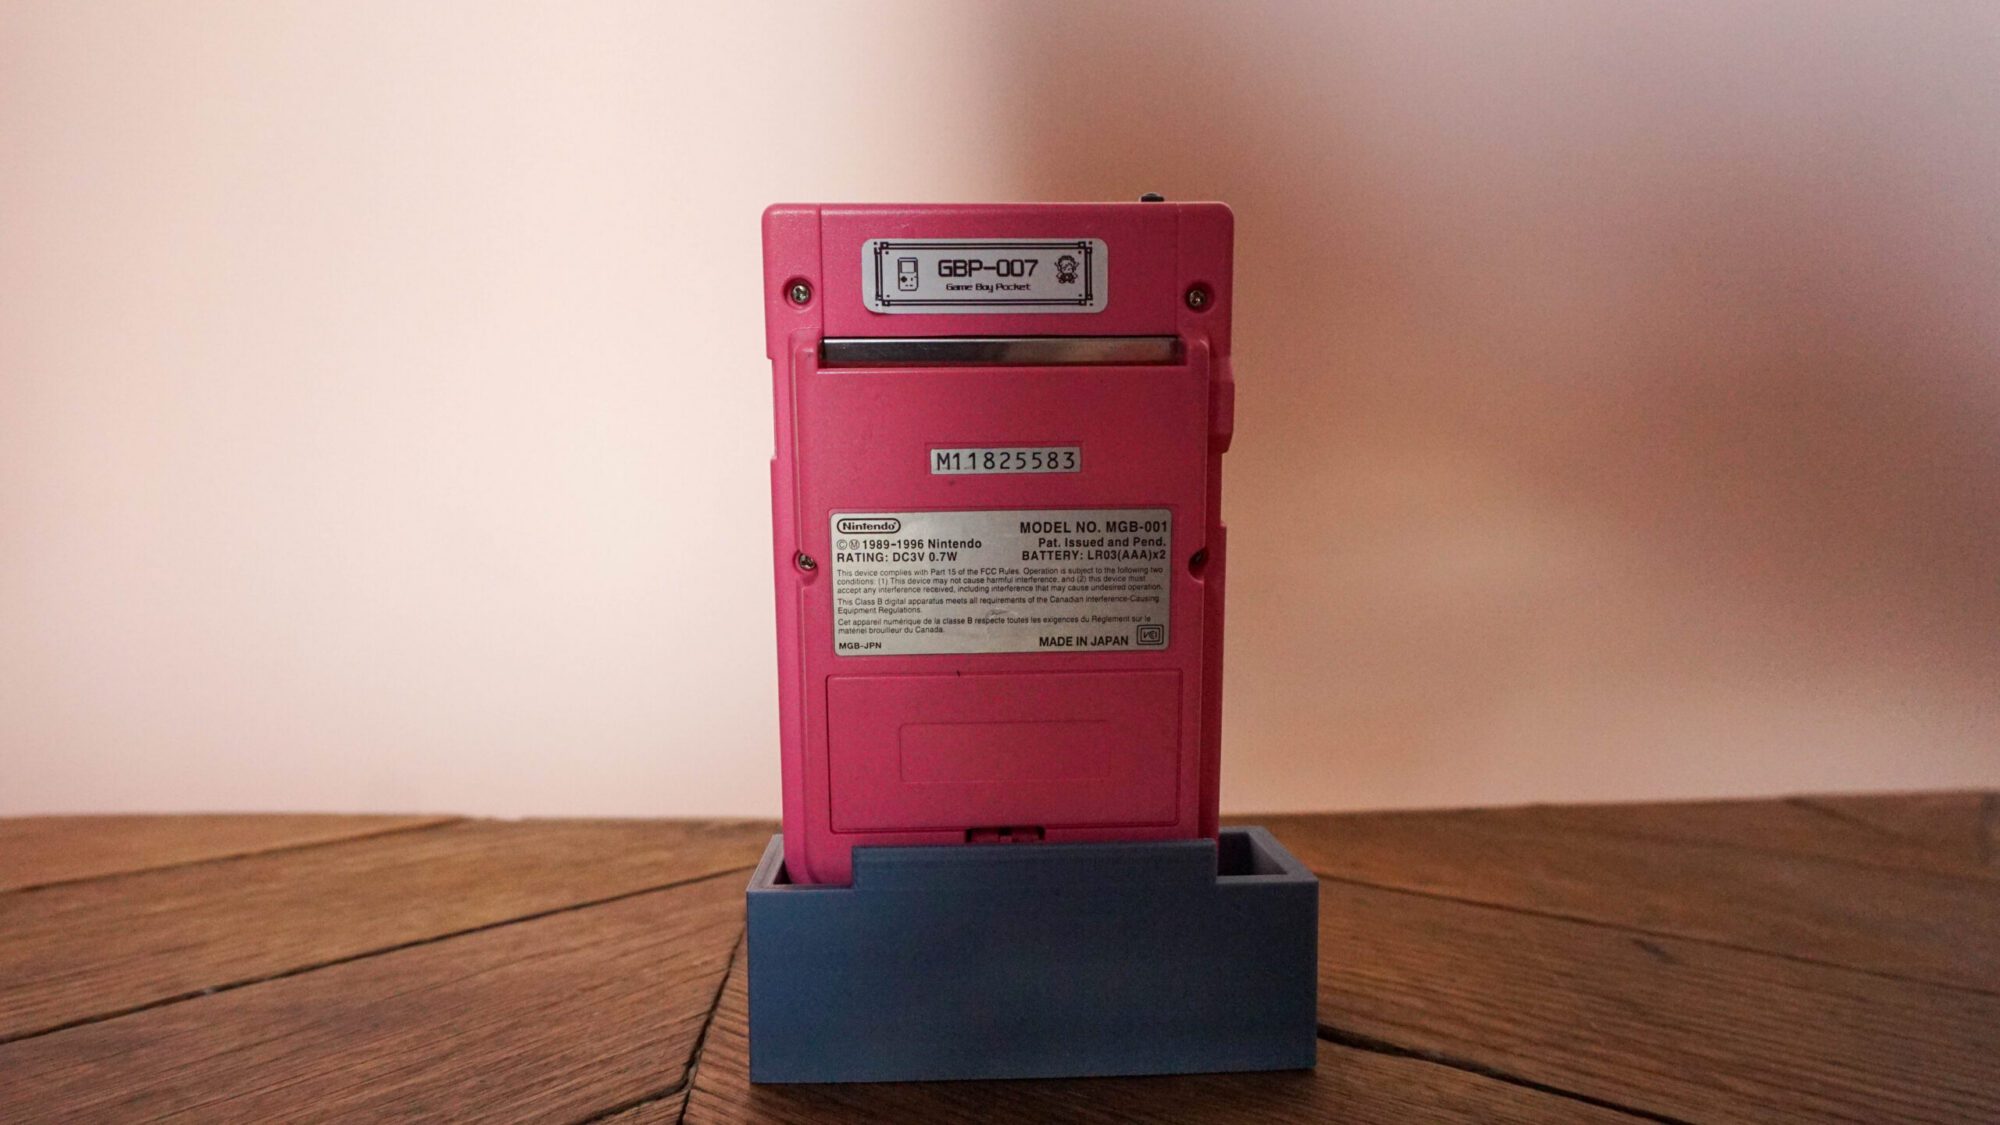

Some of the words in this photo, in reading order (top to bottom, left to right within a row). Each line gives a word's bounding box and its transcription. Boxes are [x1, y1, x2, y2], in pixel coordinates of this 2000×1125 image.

[938, 259, 1038, 277] GBP-007
[946, 283, 973, 291] Game
[976, 283, 994, 293] Boy
[996, 283, 1031, 291] Pocket
[937, 452, 1075, 471] M11825583
[1020, 521, 1071, 534] MODEL
[1076, 521, 1101, 533] NO.
[1106, 521, 1167, 532] MGB-001
[862, 539, 924, 550] 1989-1996
[928, 538, 982, 549] Nintendo
[1038, 538, 1061, 548] Pat.
[1064, 537, 1104, 547] Issued
[1107, 537, 1129, 547] and
[1133, 537, 1166, 547] Pend.
[837, 552, 888, 563] RATING:
[893, 552, 925, 562] DC3V
[929, 551, 958, 561] 0.7W
[1022, 550, 1084, 561] BATTERY:
[1087, 550, 1166, 561] LR03(AAA)x2
[837, 569, 852, 577] This
[880, 569, 912, 578] complies
[958, 568, 966, 576] of
[967, 568, 978, 576] the
[1023, 568, 1058, 576] Operation
[1068, 567, 1093, 576] subject
[1117, 567, 1149, 576] following
[878, 578, 888, 586] (1)
[908, 577, 931, 585] device
[933, 578, 948, 586] may
[987, 576, 1013, 584] harmful
[837, 587, 862, 595] accept
[863, 587, 876, 595] any
[878, 586, 922, 594] interference
[923, 586, 956, 594] received,
[957, 586, 989, 595] including
[991, 585, 1033, 593] interference
[1051, 585, 1066, 593] may
[837, 598, 853, 606] This
[855, 598, 876, 606] Class
[884, 598, 906, 607] digital
[908, 598, 944, 607] apparatus
[980, 596, 1026, 606] requirements
[1085, 595, 1160, 604] Interference-Causing
[837, 607, 876, 615] Equipment
[853, 618, 882, 627] appareil
[942, 617, 966, 625] classe
[974, 618, 1005, 626] respecte
[1043, 616, 1079, 625] exigences
[839, 642, 882, 650] MGB-JPN
[1039, 636, 1073, 647] MADE
[1076, 636, 1088, 646] IN
[1091, 636, 1129, 646] JAPAN
